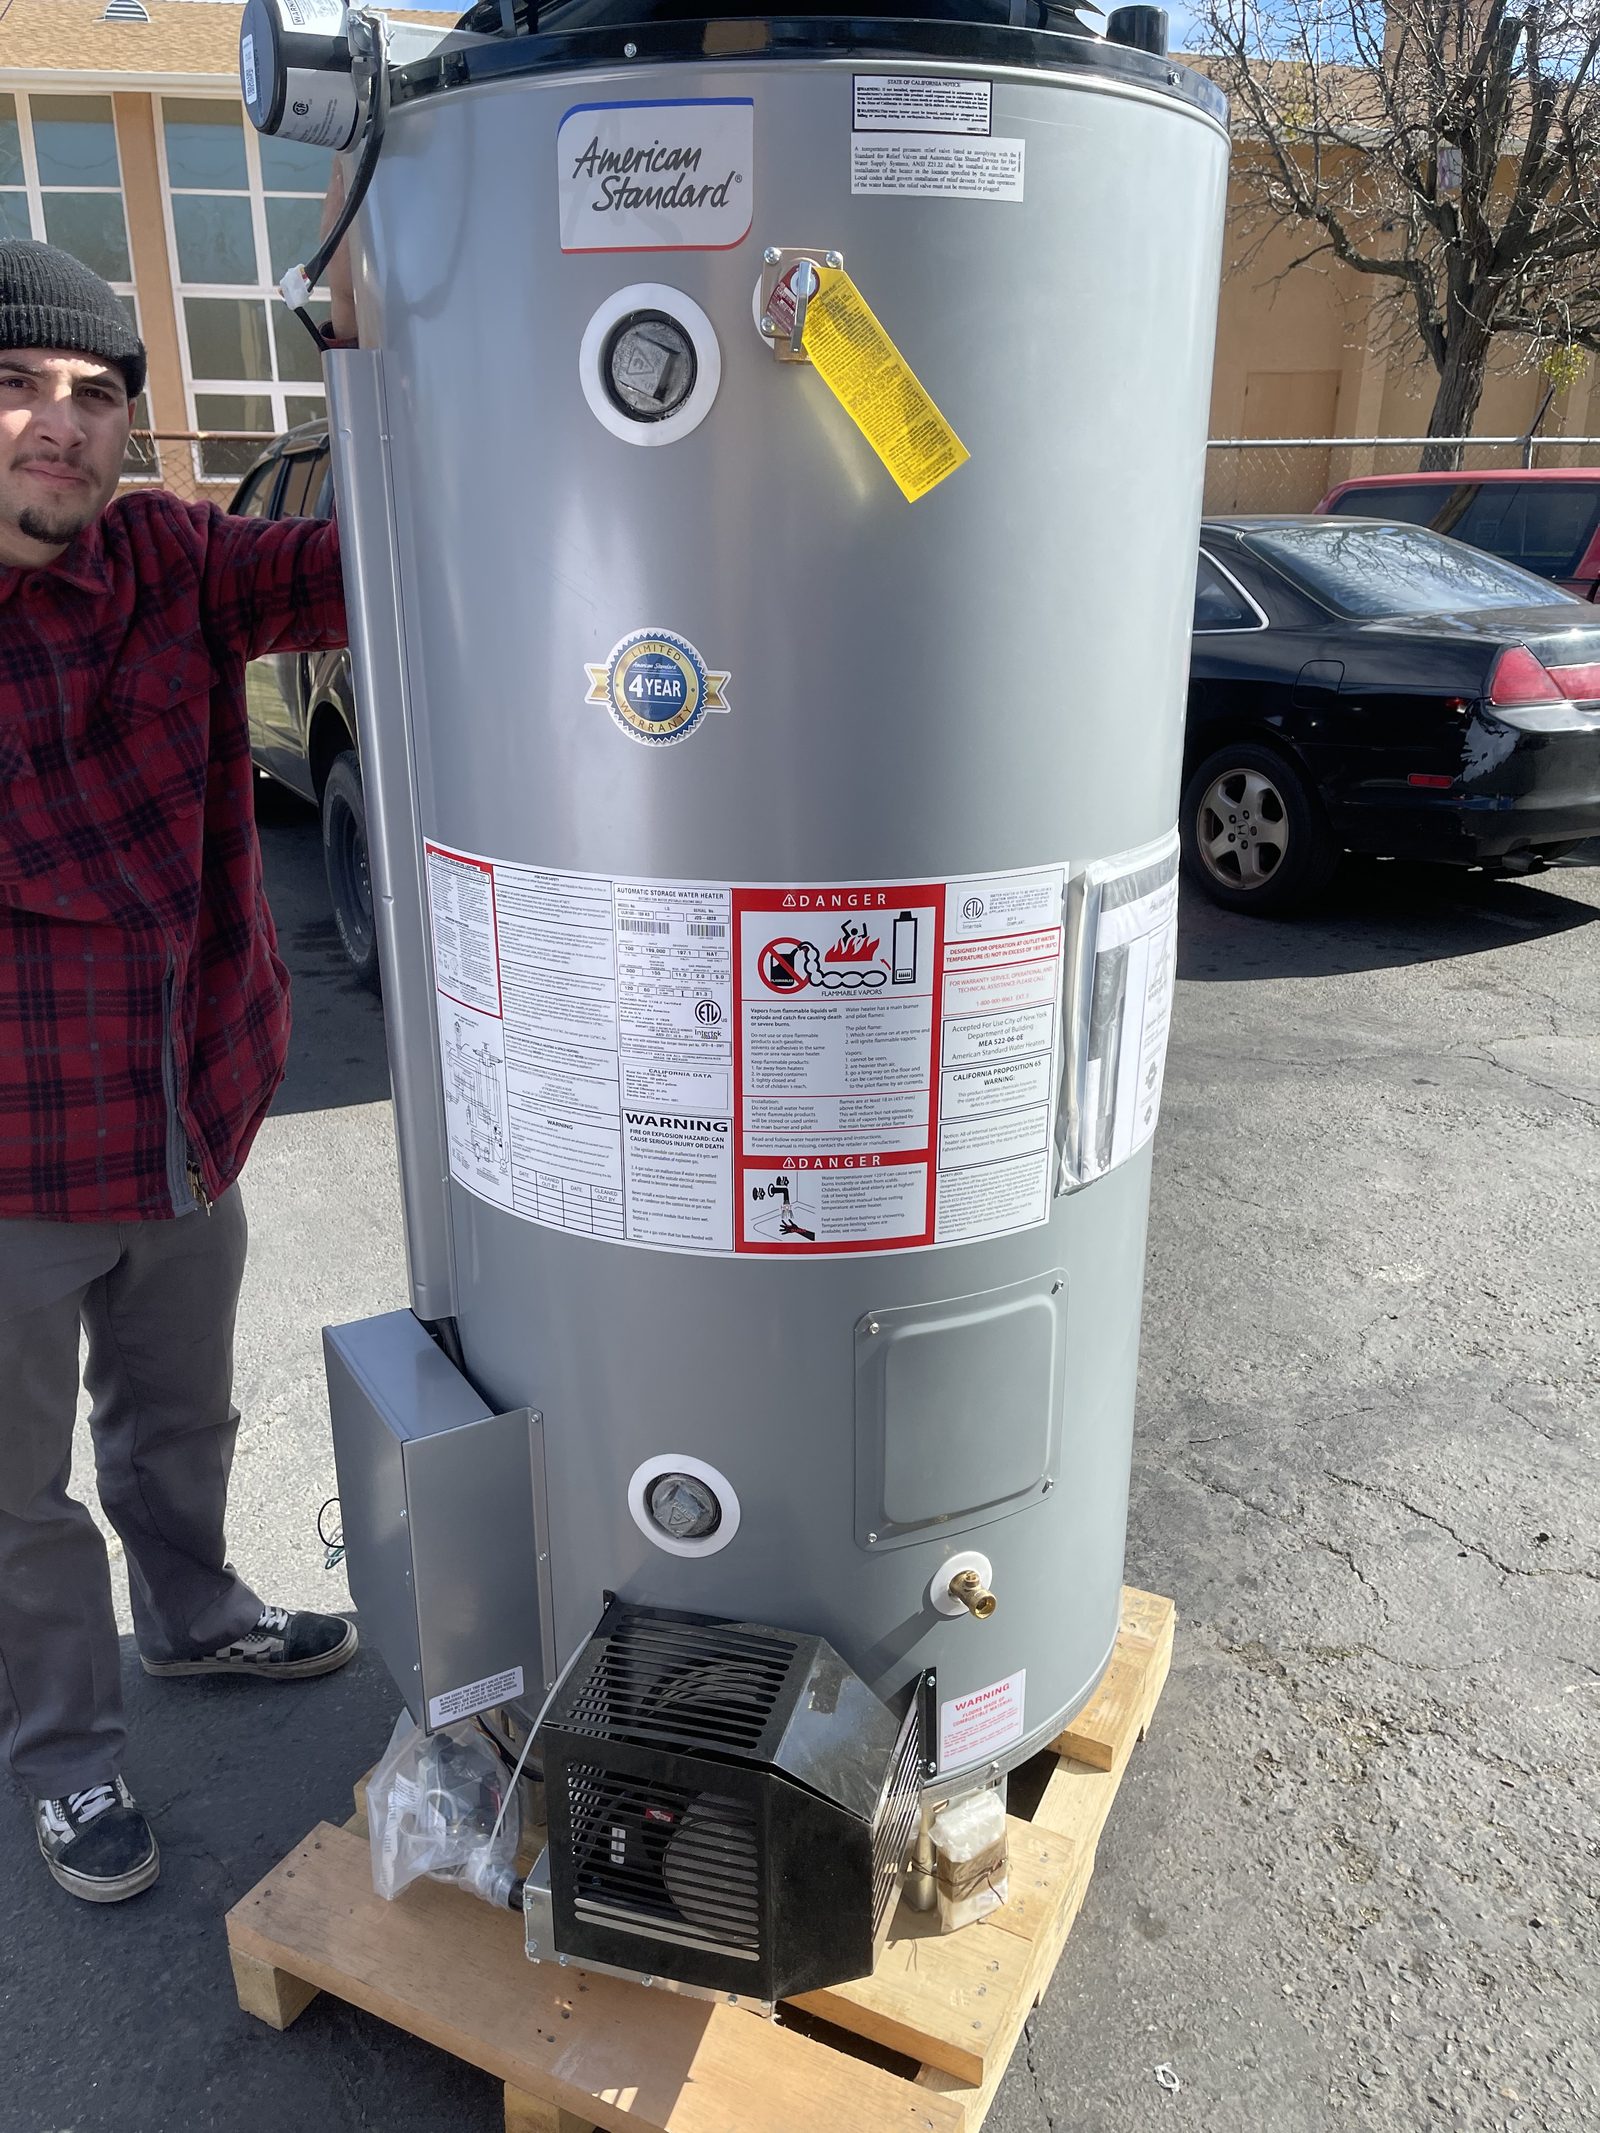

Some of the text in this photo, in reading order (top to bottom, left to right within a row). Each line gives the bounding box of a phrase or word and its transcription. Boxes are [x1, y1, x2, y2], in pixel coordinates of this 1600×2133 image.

[572, 136, 702, 178] American
[632, 644, 681, 662] LIMITED
[628, 674, 681, 698] 4 YEAR
[620, 701, 692, 732] WARRANTY
[800, 893, 886, 907] DANGER
[950, 946, 977, 954] DESIGNED
[988, 941, 1016, 950] OPERATION
[947, 954, 983, 963] TEMPERATURE
[958, 984, 986, 993] TECHNICAL
[1016, 977, 1032, 986] PLEASE
[961, 976, 989, 985] WARRANTY
[952, 1022, 981, 1033] Accepted
[982, 1020, 991, 1029] For
[993, 1019, 1003, 1027] Use
[1004, 1017, 1015, 1025] City
[1023, 1013, 1035, 1022] New
[695, 1029, 722, 1037] Intertek
[968, 1028, 1003, 1040] Department
[1012, 1023, 1033, 1033] Building
[952, 1039, 1044, 1060] American Standard Water Heaters
[649, 1069, 690, 1077] CALIFORNIA
[953, 1069, 992, 1081] CALIFORNIA
[993, 1062, 1033, 1074] PROPOSITION
[547, 1120, 573, 1130] WARNING
[625, 1113, 728, 1132] WARNING
[649, 1137, 672, 1145] SERIOUS
[652, 1130, 683, 1139] EXPLOSION
[799, 1155, 881, 1169] DANGER
[539, 1174, 560, 1184] CLEANED
[594, 1188, 618, 1197] CLEANED
[955, 1683, 1010, 1711] WARNING
[953, 1710, 988, 1726] COMBUSTIBLE
